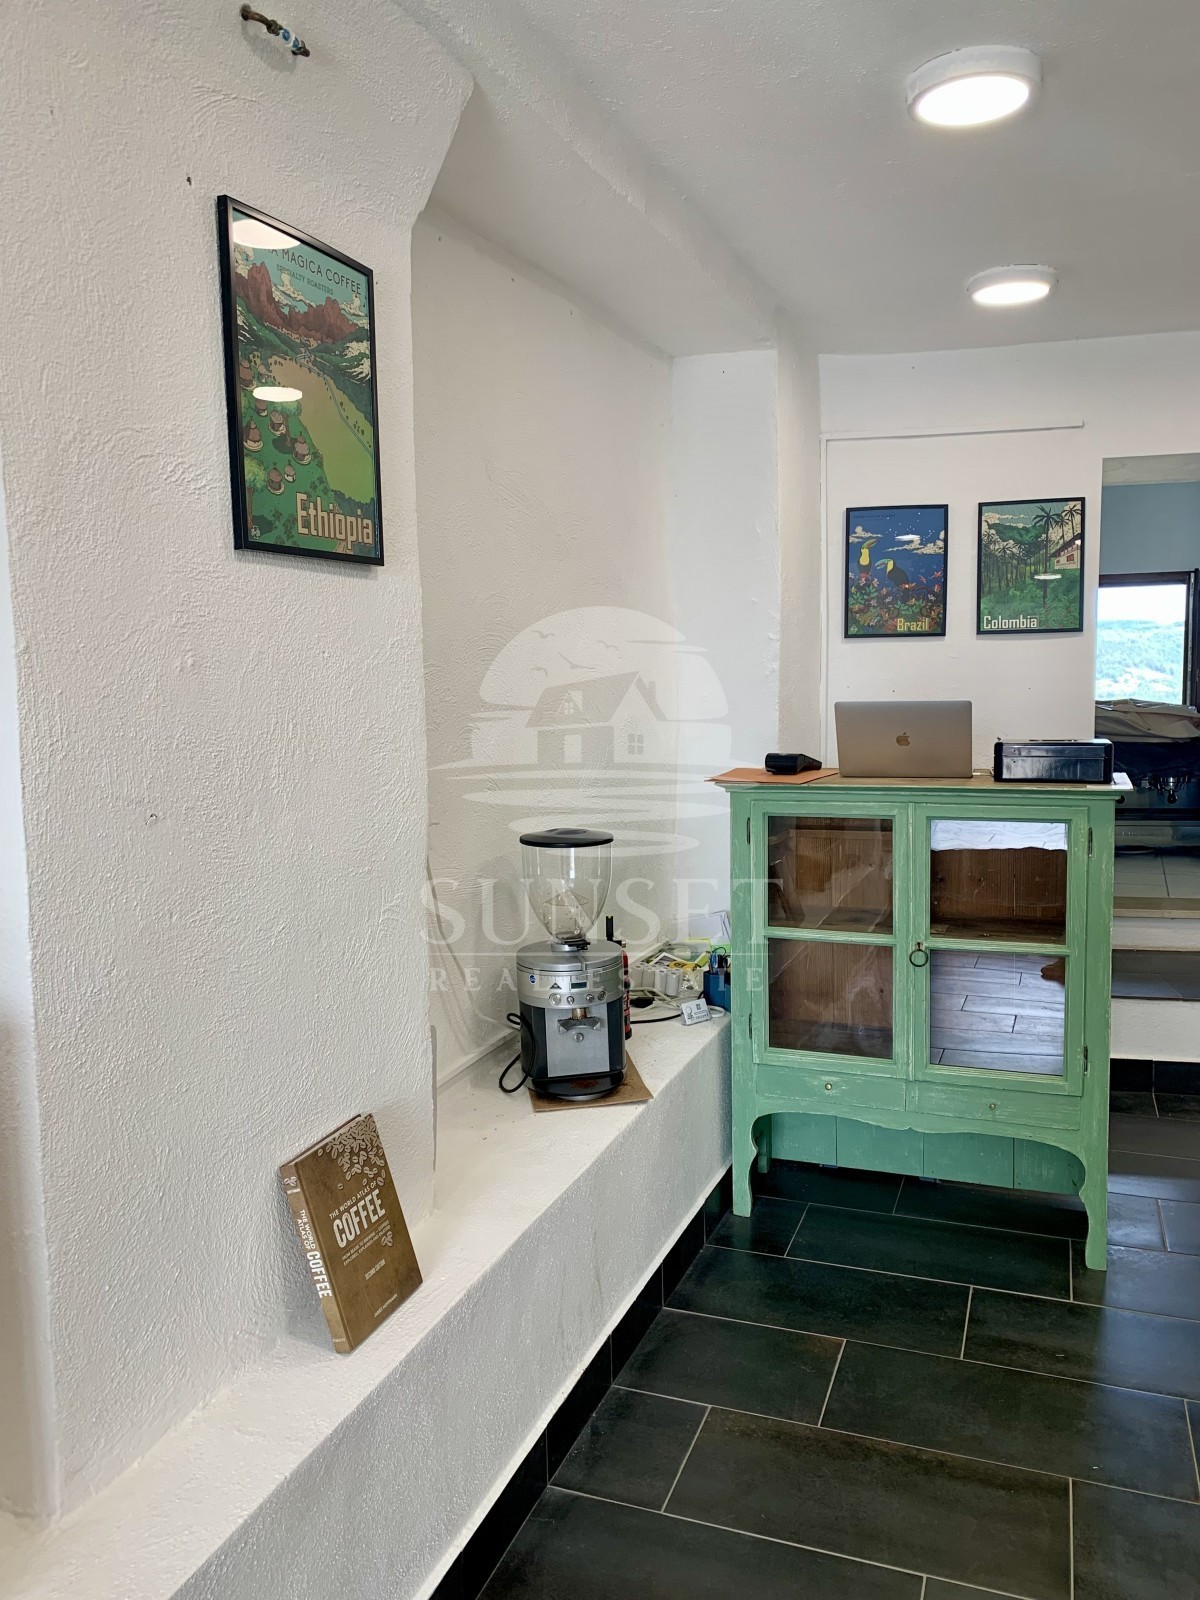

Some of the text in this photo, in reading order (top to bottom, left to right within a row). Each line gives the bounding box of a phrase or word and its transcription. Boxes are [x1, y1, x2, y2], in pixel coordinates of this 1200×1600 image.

[282, 249, 361, 295] MAGICA COFFEE
[307, 278, 334, 296] ROASTERS
[296, 492, 373, 549] Ethiopia
[897, 618, 930, 632] Brazil
[983, 615, 1038, 630] Colombia
[329, 1180, 377, 1220] THE WORLD ATLAS OF
[333, 1188, 386, 1249] COFFEE
[297, 1218, 311, 1250] ATLAS OF
[300, 1209, 316, 1249] THE WORLD
[306, 1250, 333, 1299] COFFEE
